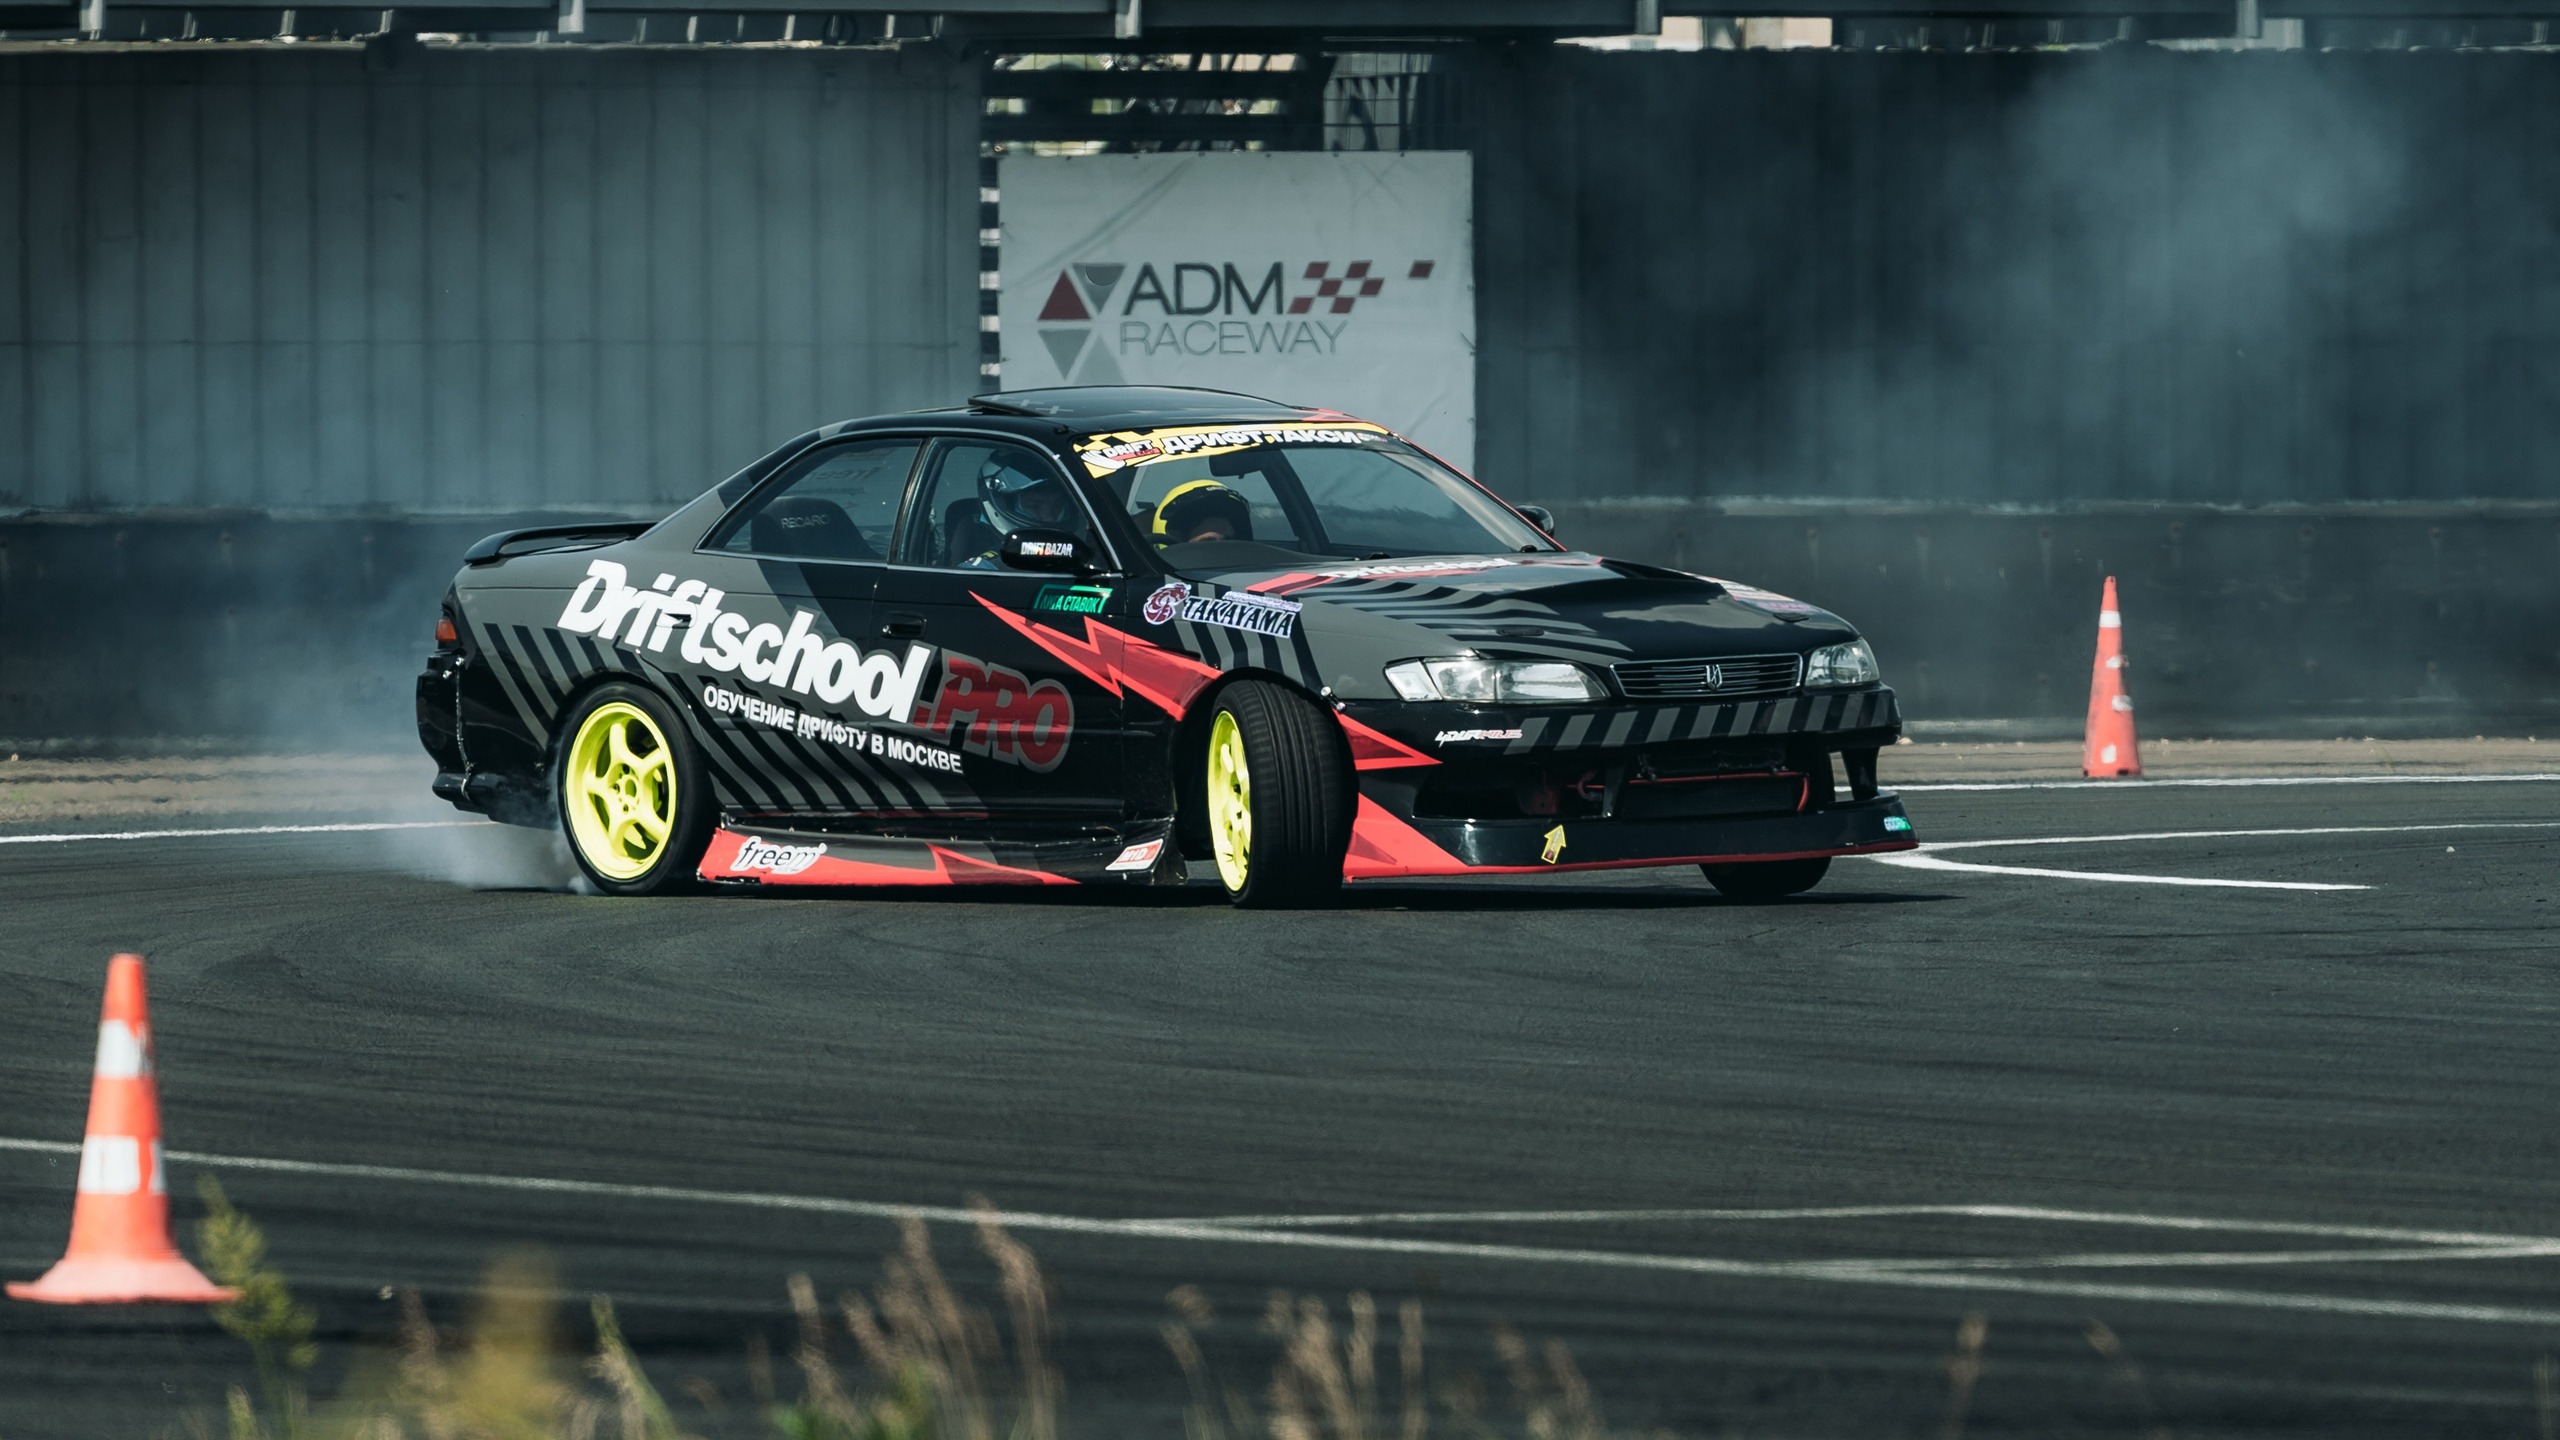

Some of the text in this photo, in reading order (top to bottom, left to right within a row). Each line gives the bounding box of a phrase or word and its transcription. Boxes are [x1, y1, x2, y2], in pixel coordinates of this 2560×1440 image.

[1121, 261, 1284, 315] ADM
[1119, 320, 1348, 356] RACEWAY
[1102, 440, 1154, 458] DRIFT
[781, 514, 831, 529] RECARO
[1021, 541, 1073, 558] DRIFT BAZAR
[1062, 595, 1101, 613] СТАВОК
[1183, 598, 1294, 636] TAKAYAMA
[703, 685, 964, 775] ОБУЧЕНИЕ ДРИФТУ В МОСКВЕ
[736, 840, 817, 868] freem
